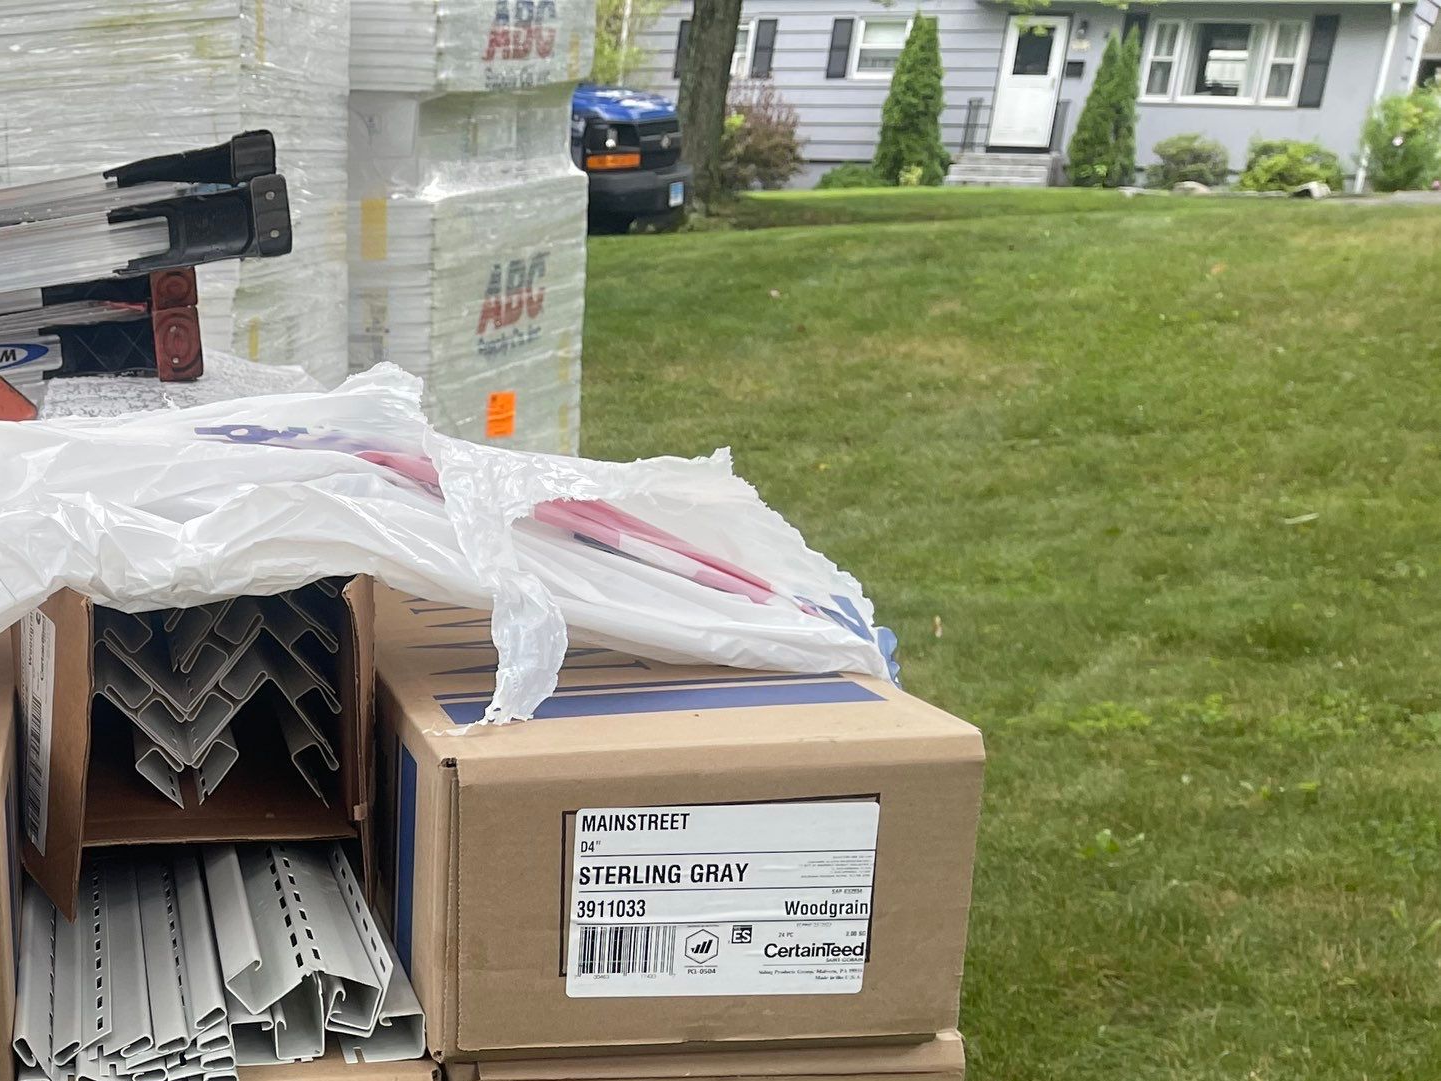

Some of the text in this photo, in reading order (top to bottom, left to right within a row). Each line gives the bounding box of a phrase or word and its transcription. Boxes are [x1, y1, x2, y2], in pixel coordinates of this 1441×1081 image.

[482, 0, 557, 61] ABC
[477, 252, 551, 335] ABC
[582, 813, 690, 832] MAINSTREET
[581, 841, 600, 852] D4"
[579, 863, 748, 885] STERLING GRAY
[578, 900, 645, 918] 3911033
[785, 900, 867, 917] Woodgrain
[733, 929, 751, 943] ES
[765, 942, 864, 958] CertainTeed
